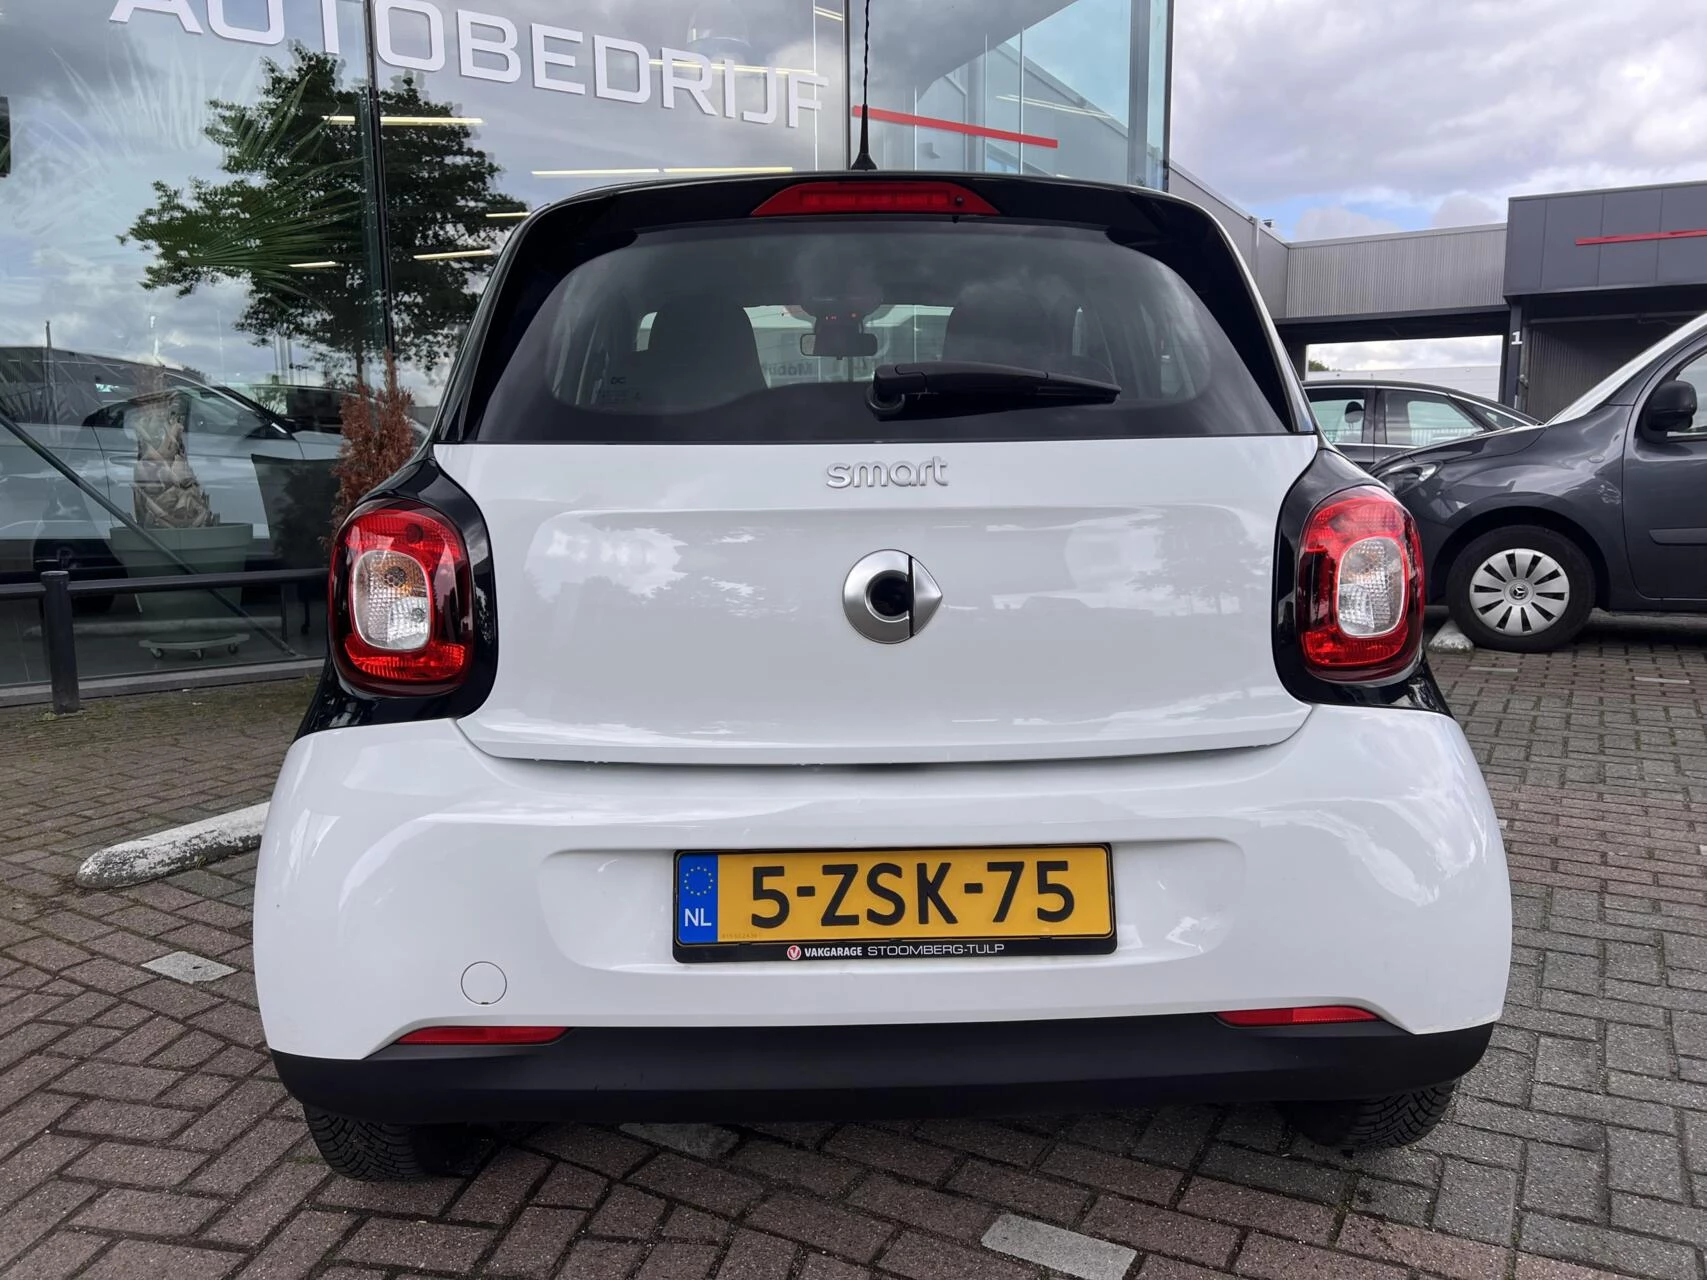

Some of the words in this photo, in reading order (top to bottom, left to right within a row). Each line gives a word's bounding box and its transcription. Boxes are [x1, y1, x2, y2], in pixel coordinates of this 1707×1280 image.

[1511, 331, 1522, 345] 1
[826, 456, 949, 489] smart
[751, 860, 1075, 929] 5-ZSK-75
[684, 908, 712, 927] NL
[804, 946, 863, 957] VAKGARAGE
[867, 944, 1005, 956] STOOMBERG-TULP
